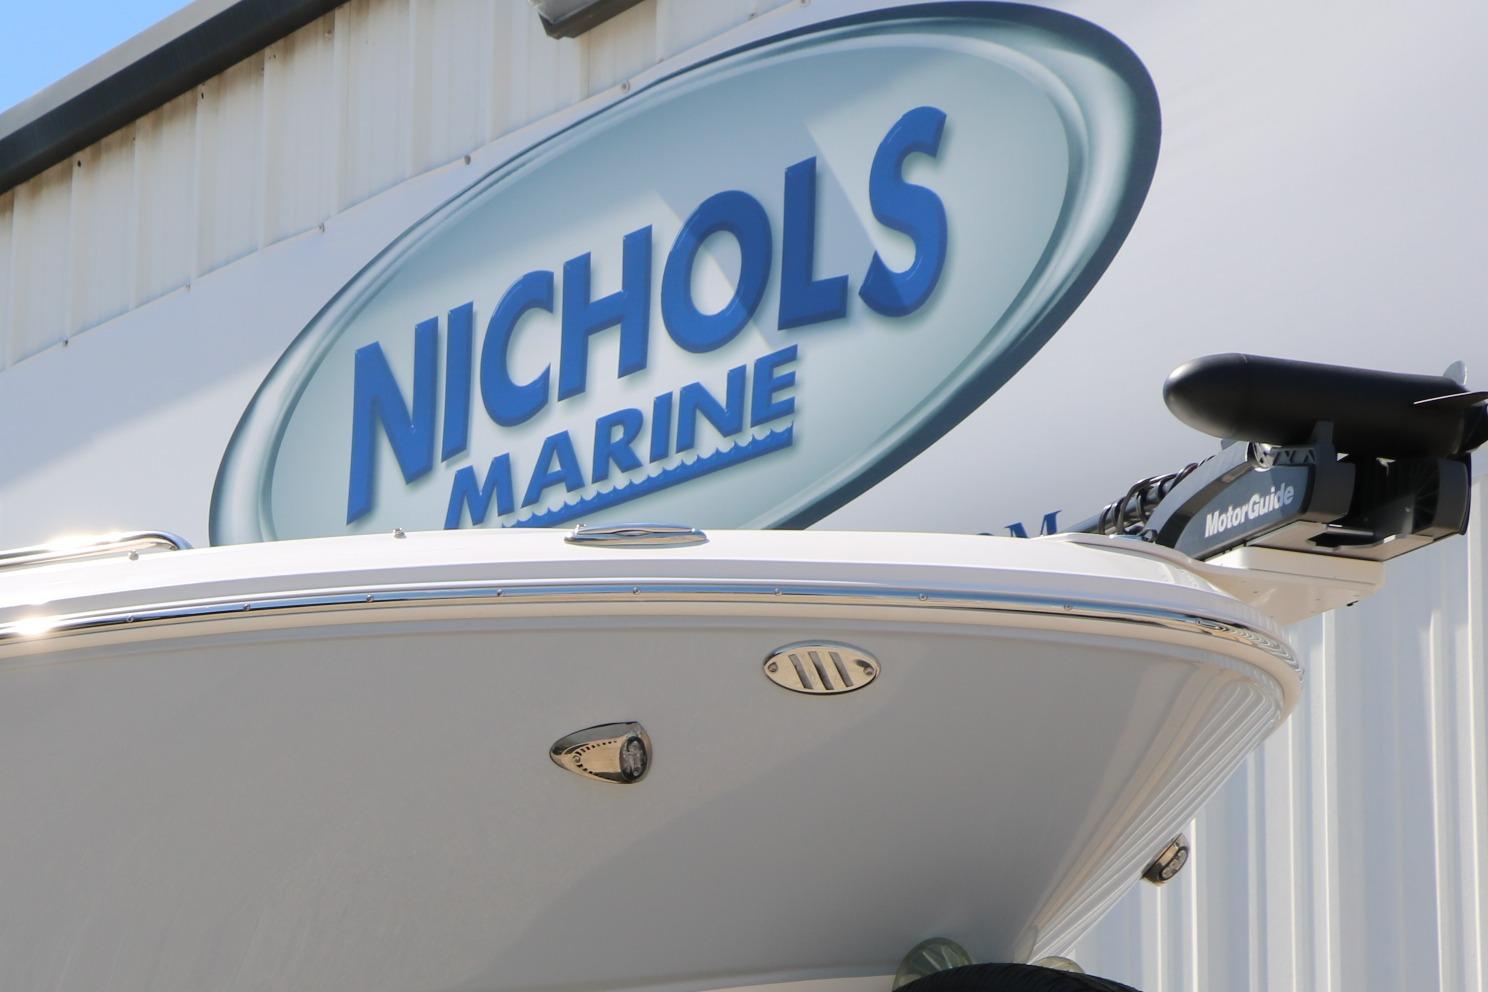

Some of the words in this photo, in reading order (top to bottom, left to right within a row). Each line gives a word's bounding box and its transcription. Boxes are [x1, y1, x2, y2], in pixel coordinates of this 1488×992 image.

[346, 105, 948, 525] NICHOLS
[444, 344, 798, 529] MARINE
[1204, 482, 1295, 539] MotorGuide
